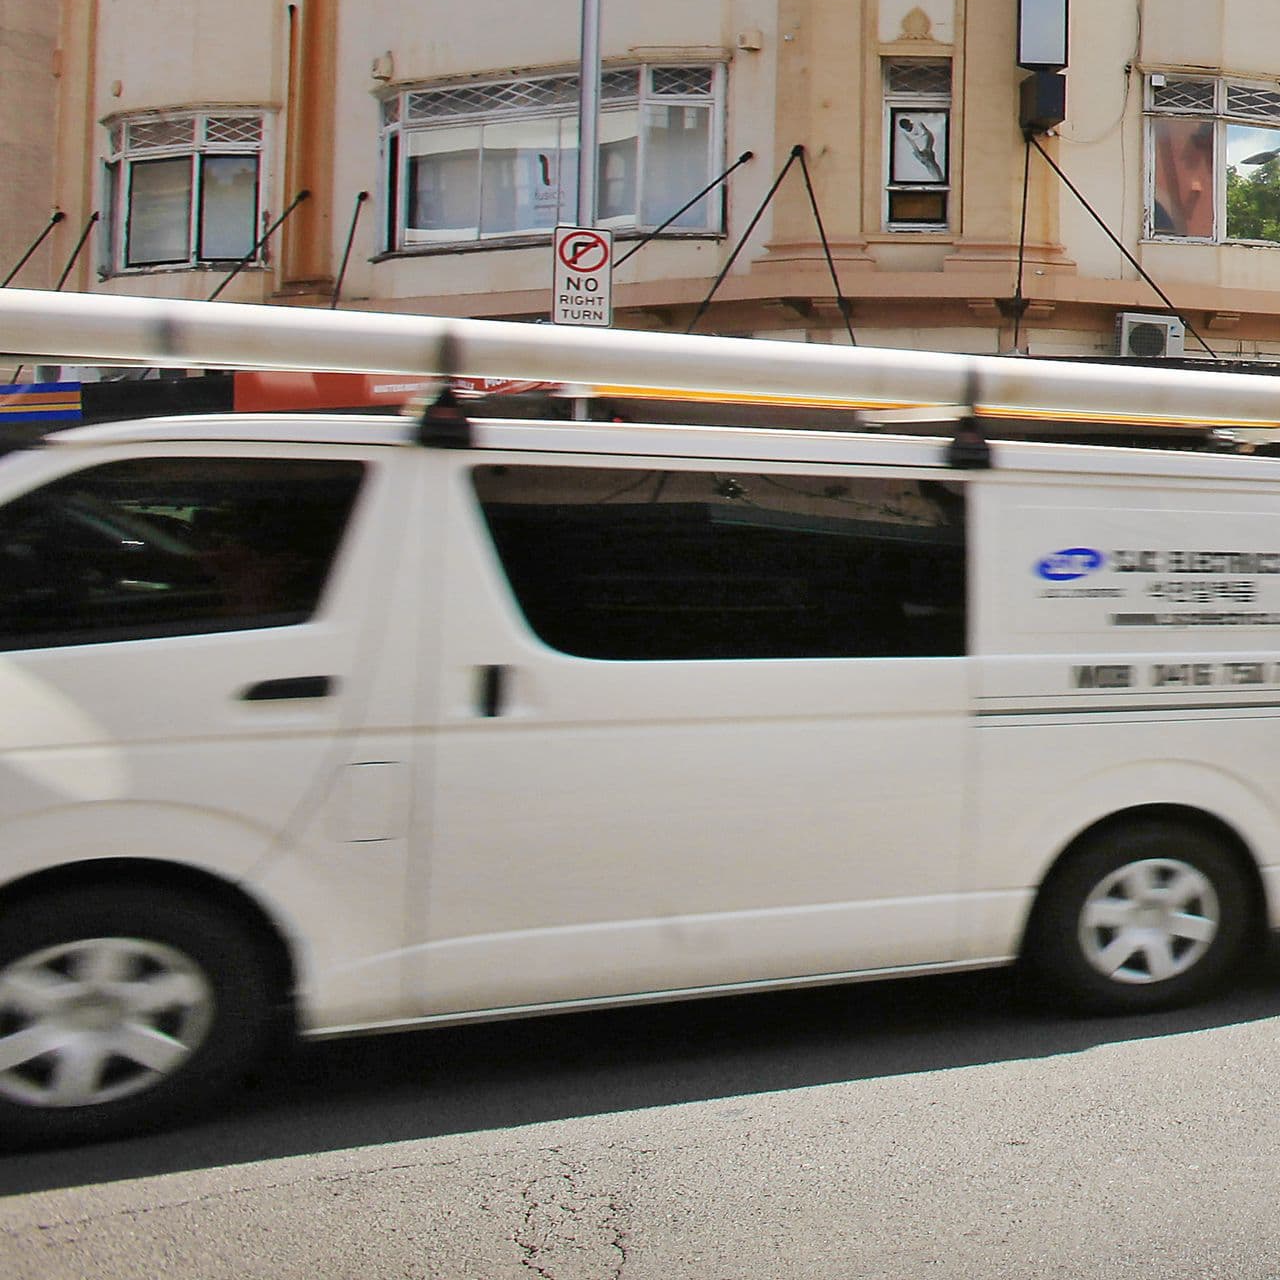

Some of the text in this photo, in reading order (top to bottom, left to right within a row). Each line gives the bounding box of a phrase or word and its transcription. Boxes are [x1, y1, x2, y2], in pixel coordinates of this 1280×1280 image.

[566, 276, 599, 292] NO
[559, 294, 605, 306] RIGHT
[561, 308, 603, 320] TURN
